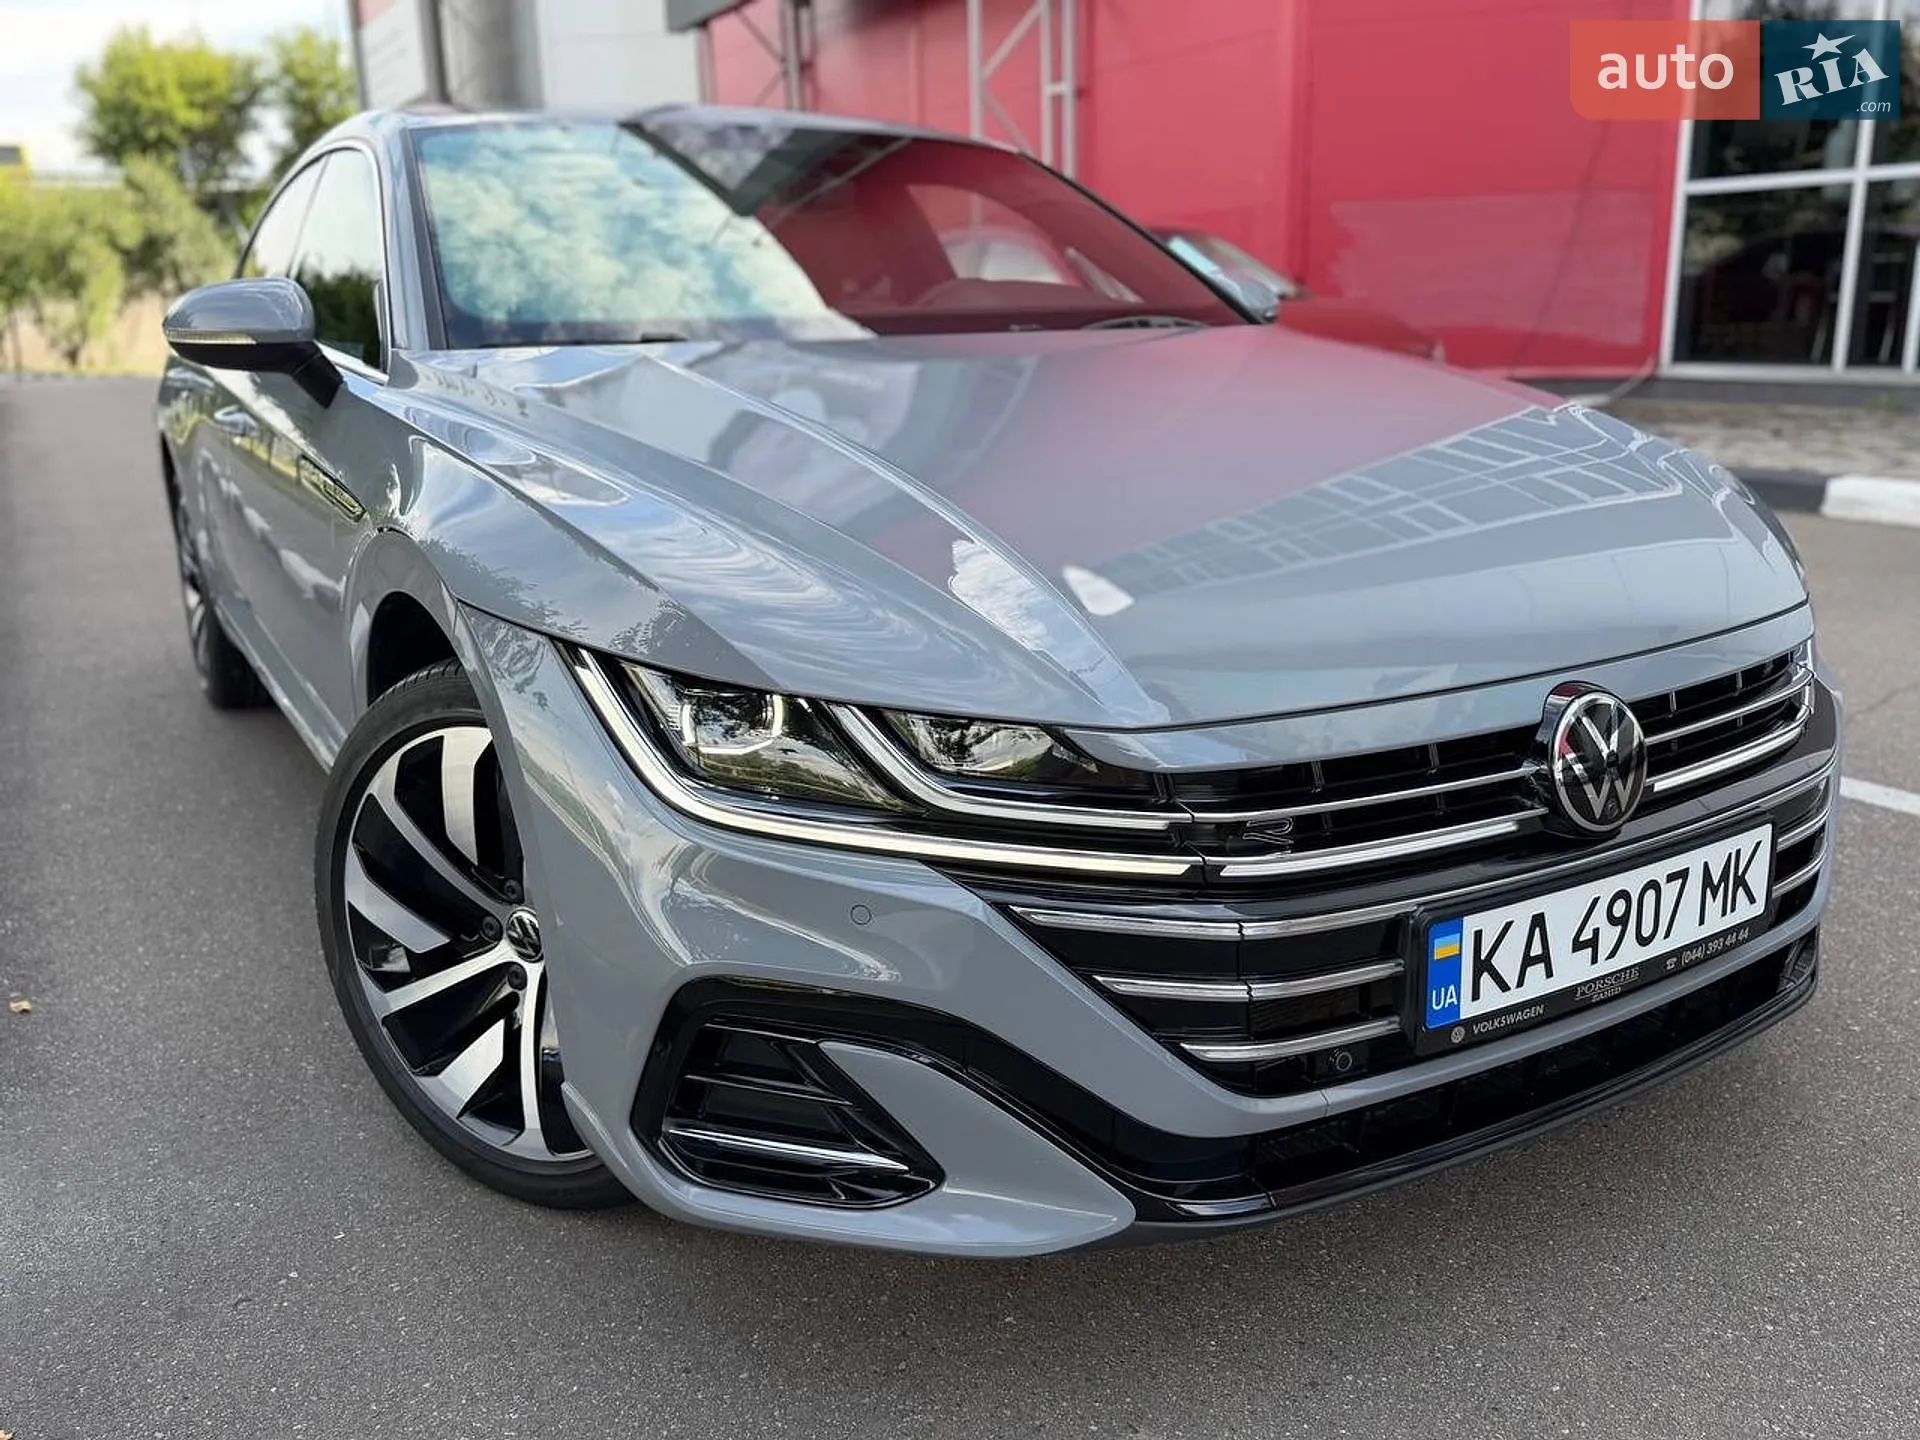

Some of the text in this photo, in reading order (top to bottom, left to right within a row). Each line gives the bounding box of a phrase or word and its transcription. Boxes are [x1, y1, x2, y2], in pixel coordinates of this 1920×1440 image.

[1471, 840, 1762, 1002] KA 4907 MK
[1432, 985, 1458, 1010] UA
[1574, 967, 1640, 998] PORSCHE
[1473, 1004, 1544, 1035] VOLKSWAGEN
